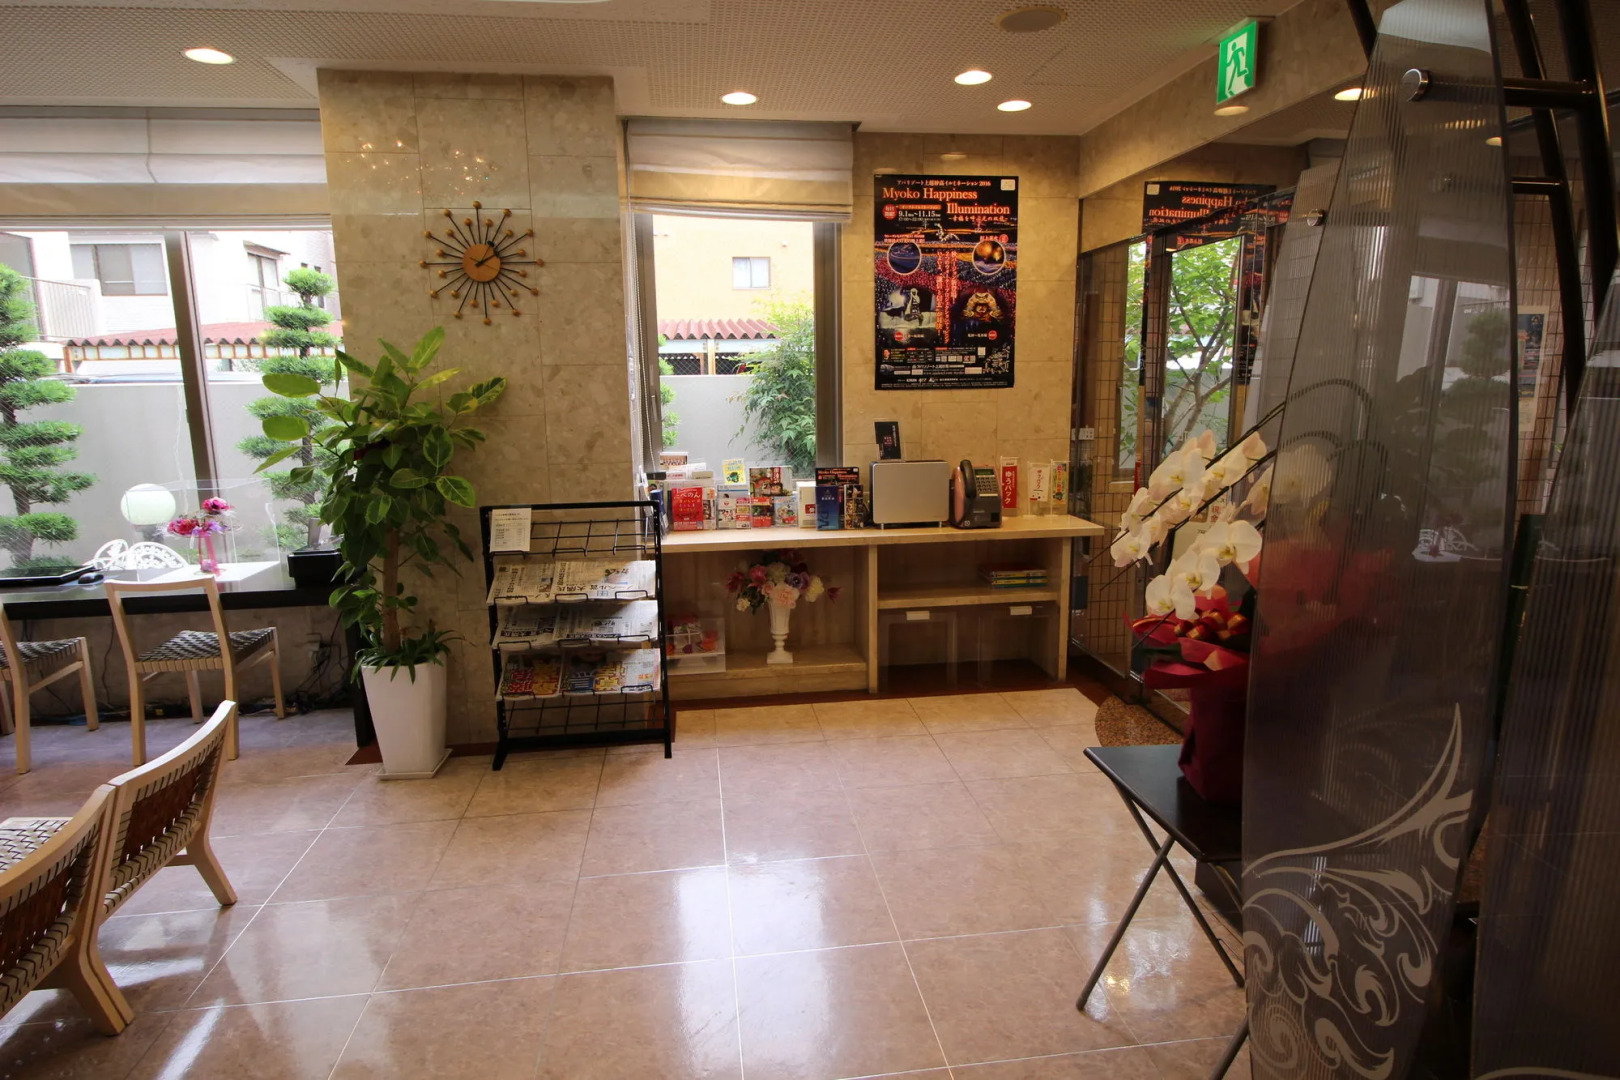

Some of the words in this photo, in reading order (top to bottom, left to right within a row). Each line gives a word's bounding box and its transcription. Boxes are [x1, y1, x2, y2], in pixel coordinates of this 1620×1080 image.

[882, 187, 920, 201] Myoko
[923, 187, 978, 201] Happiness
[946, 203, 1010, 214] Illumination
